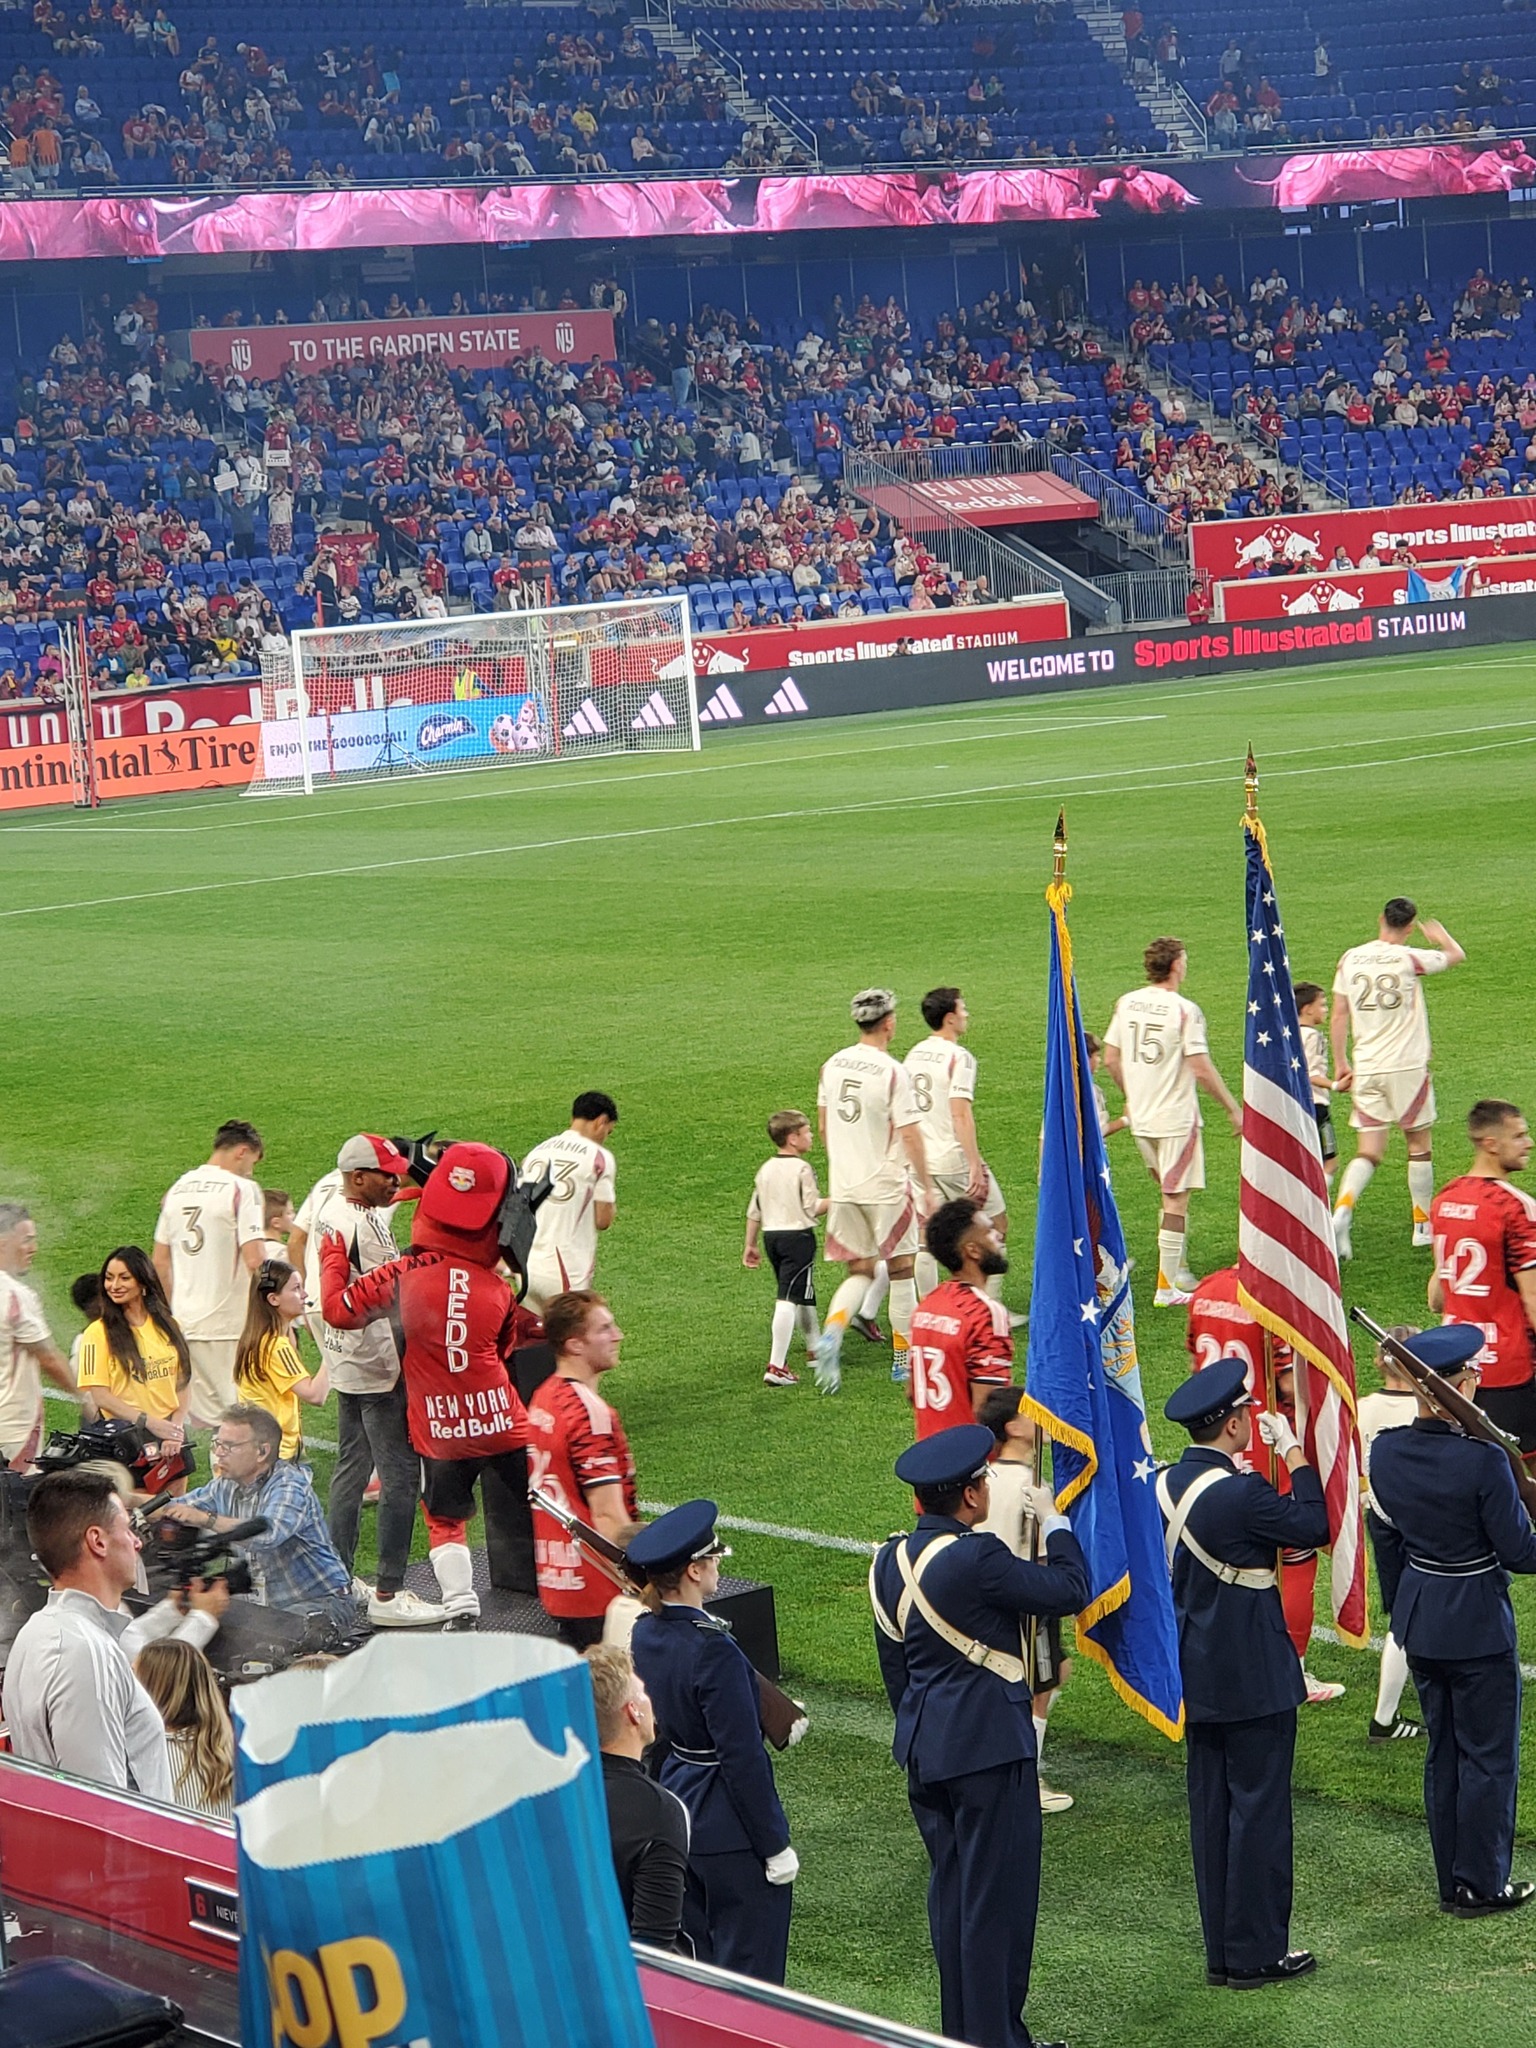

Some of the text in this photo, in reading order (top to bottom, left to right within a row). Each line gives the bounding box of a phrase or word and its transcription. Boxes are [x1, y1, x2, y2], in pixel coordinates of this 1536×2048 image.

[289, 329, 520, 362] TO THE GARDEN STATE
[982, 493, 1043, 507] Bulls
[1372, 528, 1448, 550] Sports
[788, 631, 1019, 667] Sports Illusated STADIUM
[987, 611, 1466, 683] WELCOME TO Sports Illustrated STADIUM
[421, 719, 464, 746] Charmin
[179, 736, 256, 772] Tire
[1351, 971, 1403, 1012] 28
[1128, 1021, 1166, 1065] 15
[837, 1078, 863, 1124] 5
[527, 1158, 580, 1205] 23
[181, 1206, 205, 1257] 3
[1434, 1234, 1492, 1297] 42
[446, 1268, 471, 1374] REDD
[911, 1345, 953, 1412] 13
[425, 1386, 510, 1420] NEW YORK
[430, 1420, 467, 1440] Red
[468, 1411, 515, 1438] Bulls
[260, 1935, 407, 2048] OP
